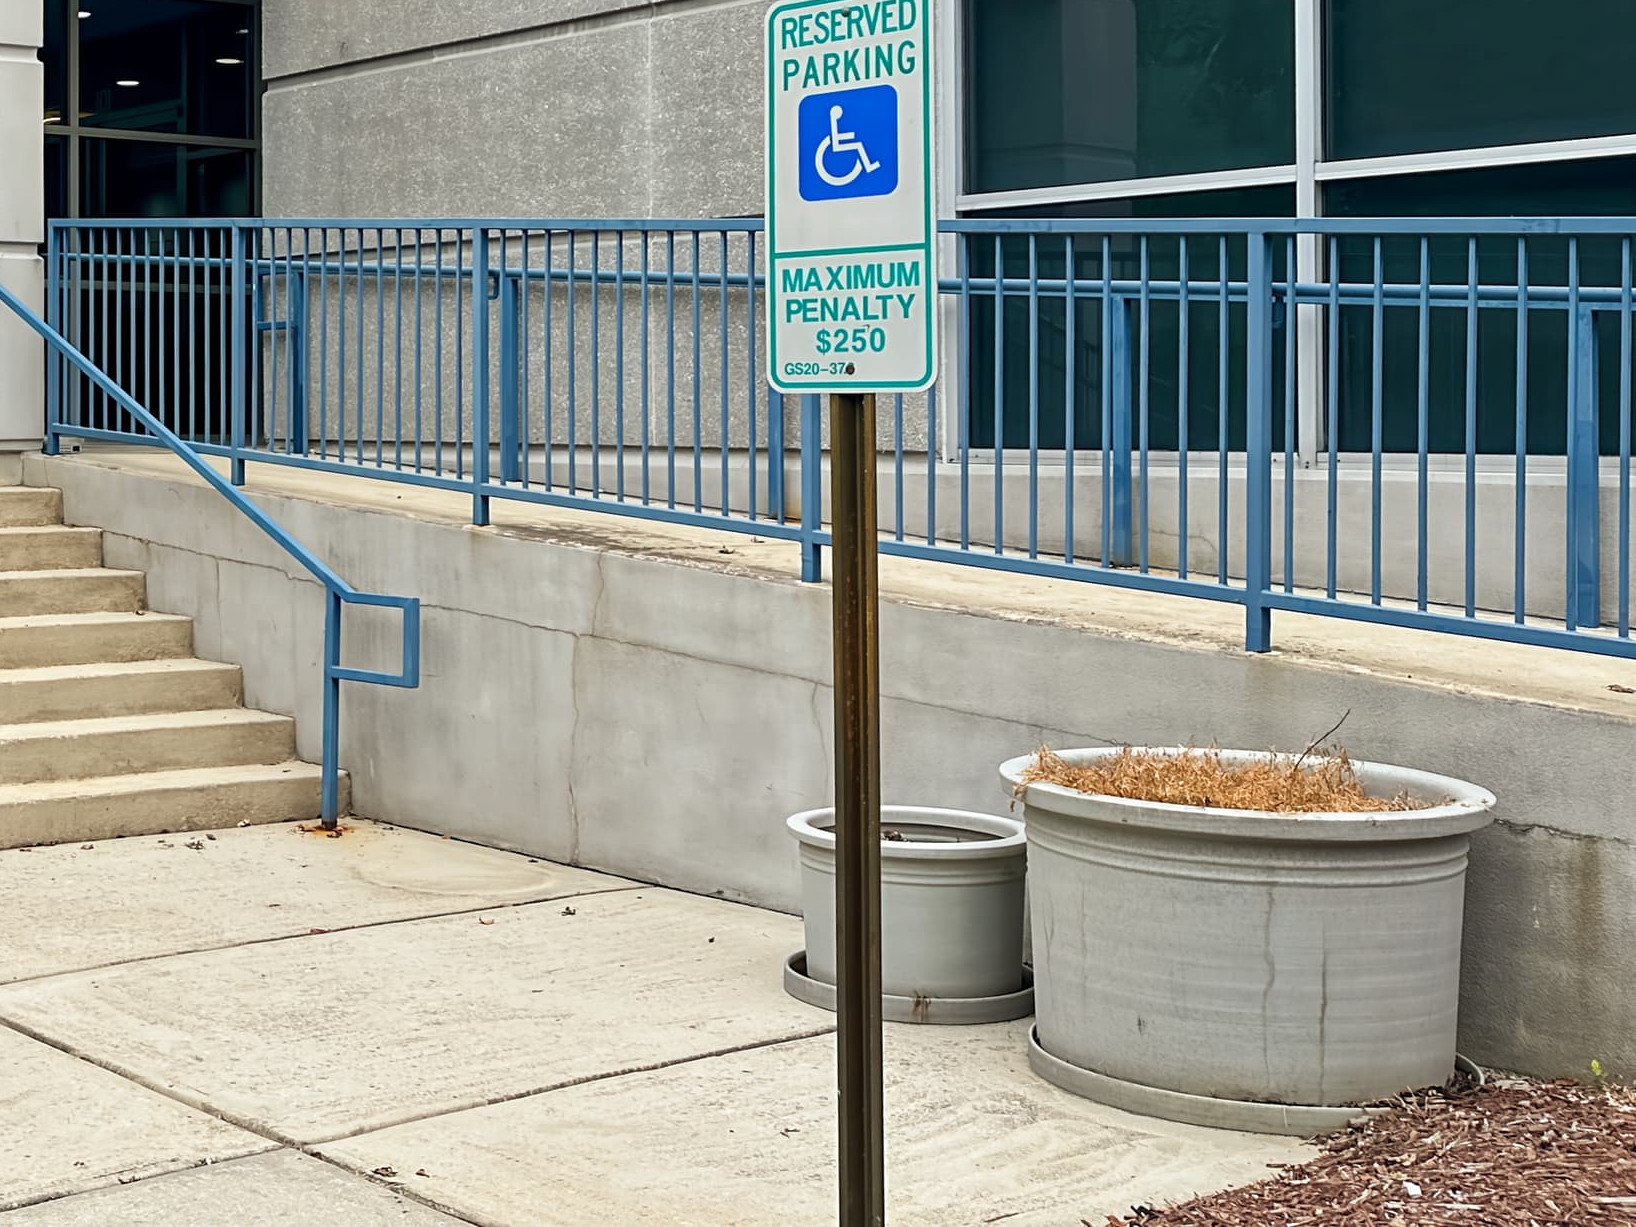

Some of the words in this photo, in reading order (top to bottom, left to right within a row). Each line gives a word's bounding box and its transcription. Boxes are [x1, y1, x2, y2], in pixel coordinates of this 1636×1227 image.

[783, 40, 916, 91] PARKING
[782, 261, 920, 293] MAXIMUM
[786, 293, 916, 323] PENALTY
[815, 327, 886, 355] $250
